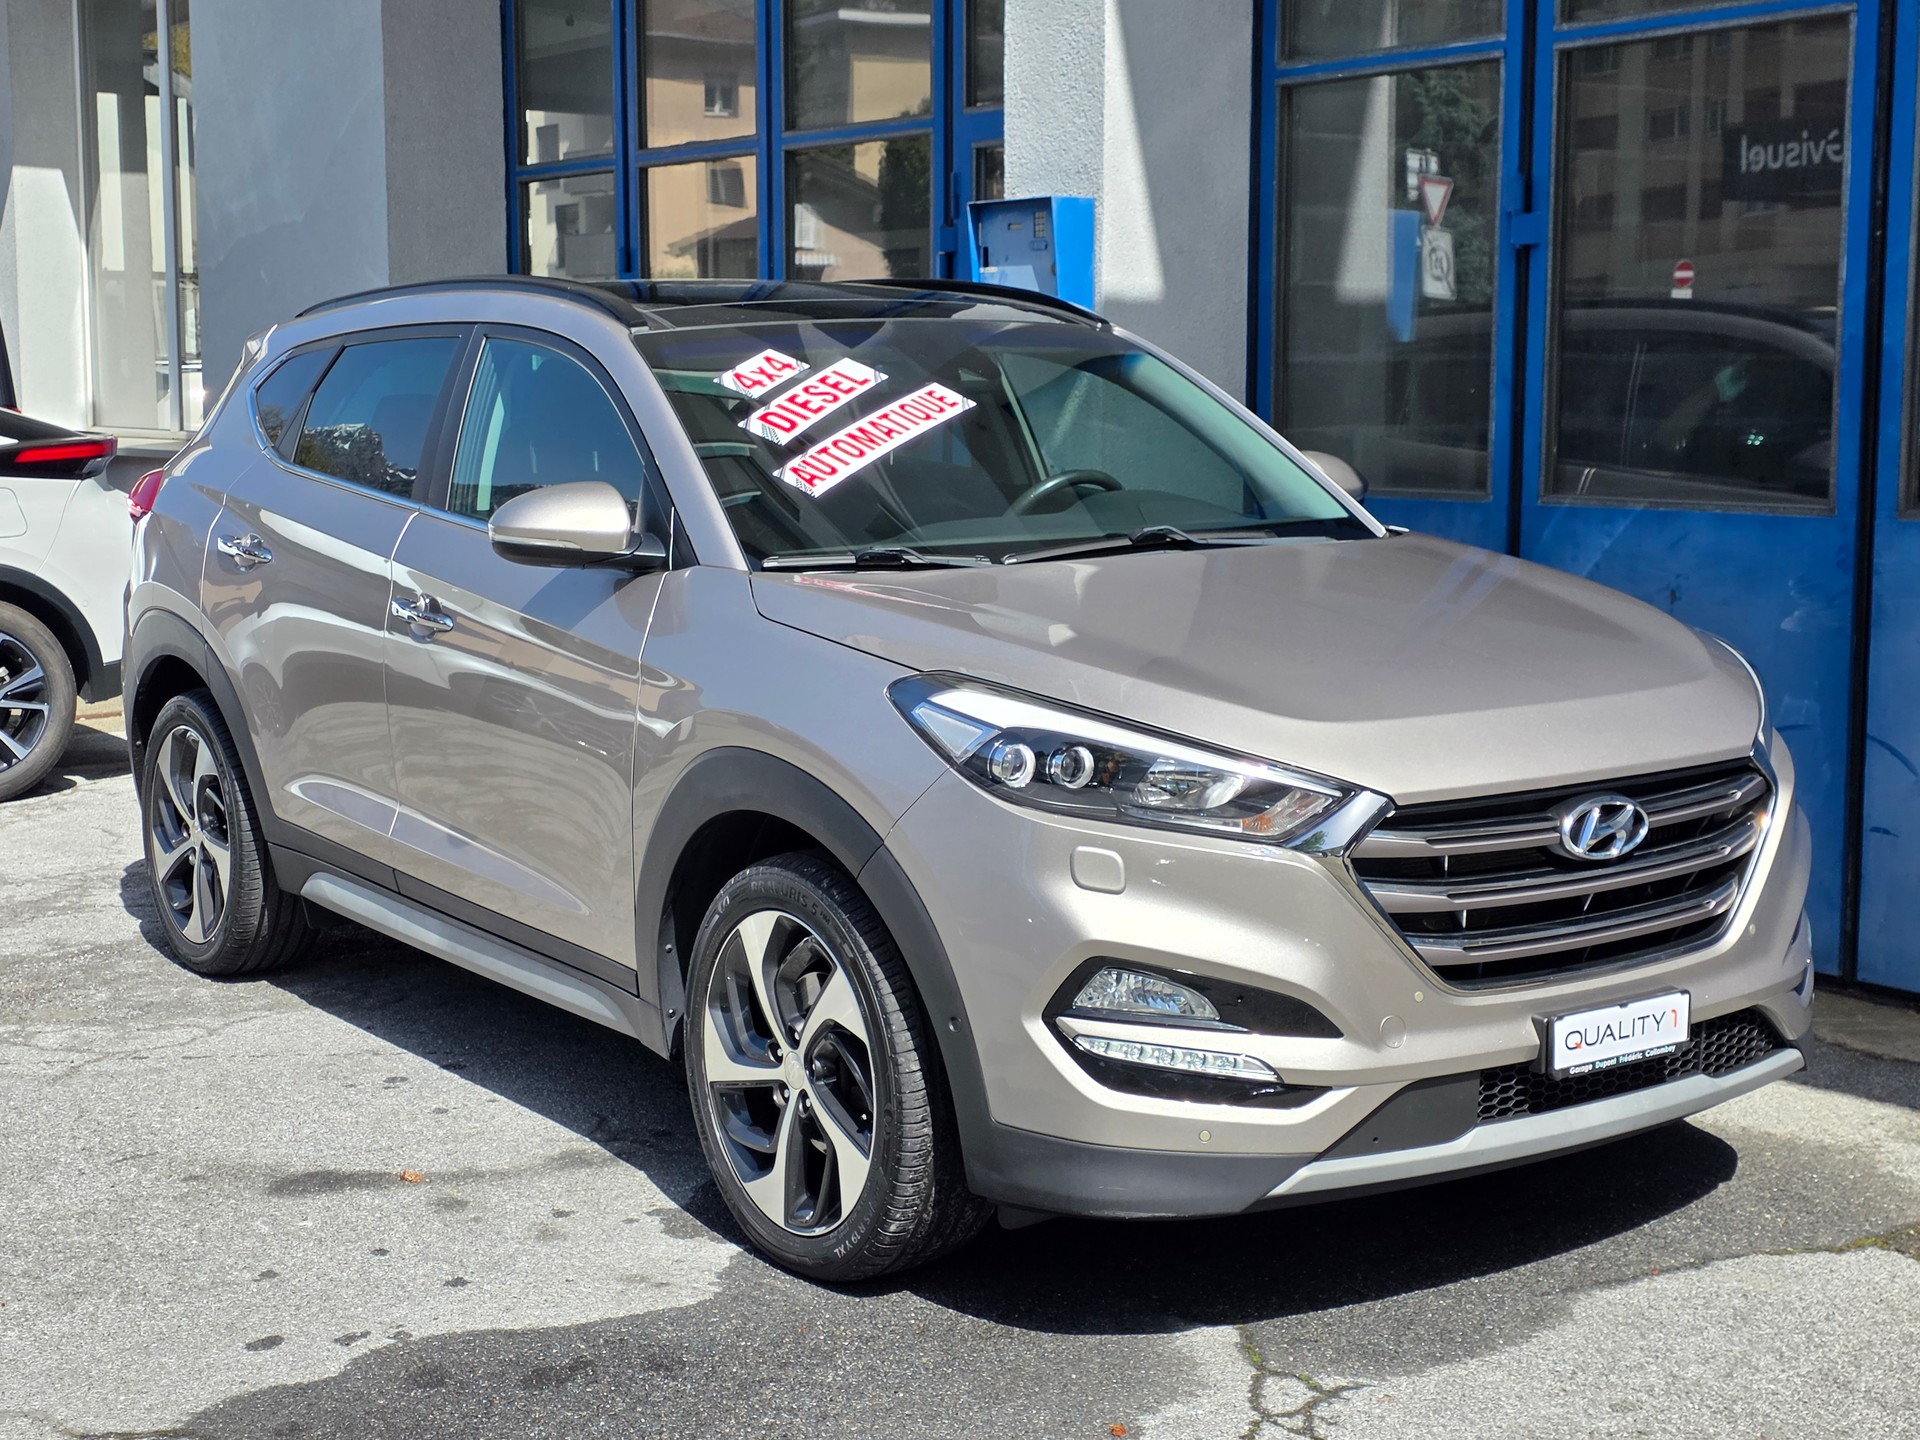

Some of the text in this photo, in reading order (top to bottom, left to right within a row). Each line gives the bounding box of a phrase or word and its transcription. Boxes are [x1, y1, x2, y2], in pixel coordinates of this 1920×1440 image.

[732, 355, 797, 390] 4x4
[756, 370, 871, 433] DIESEL
[789, 390, 960, 487] AUTOMATIQUE
[1565, 1011, 1666, 1050] QUALITY
[1569, 1045, 1676, 1075] Garage Dupont Frédéric Collombey
[833, 1247, 846, 1258] XL
[851, 1231, 861, 1244] 19
